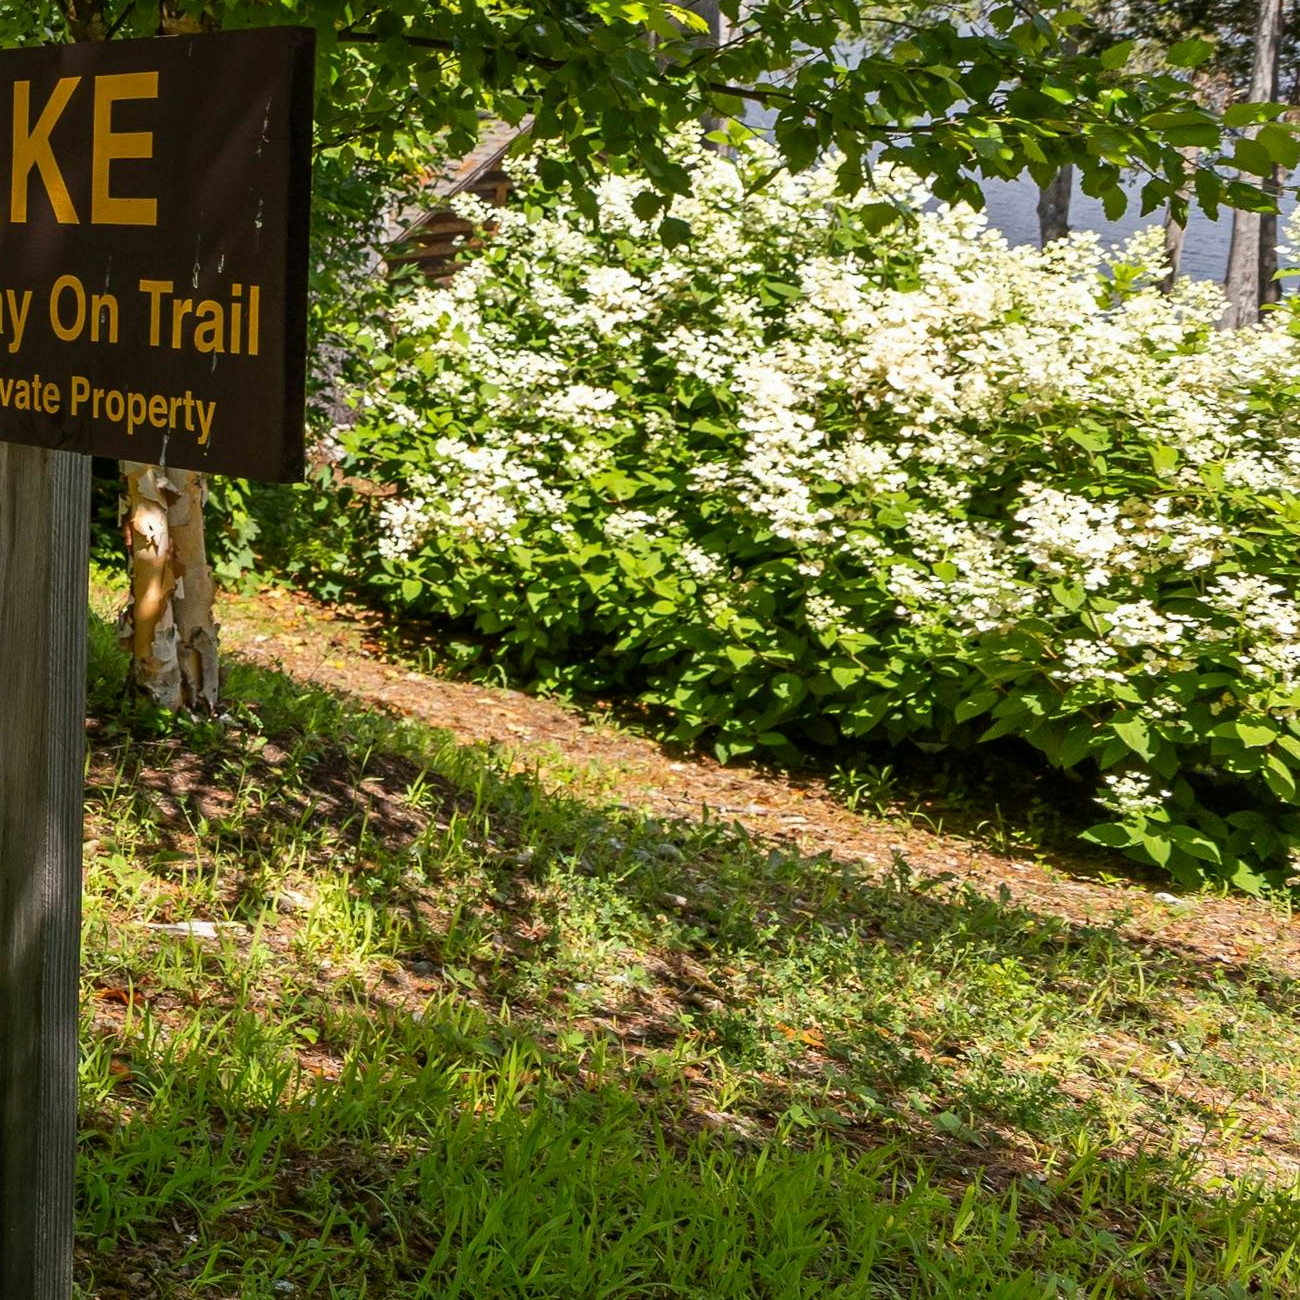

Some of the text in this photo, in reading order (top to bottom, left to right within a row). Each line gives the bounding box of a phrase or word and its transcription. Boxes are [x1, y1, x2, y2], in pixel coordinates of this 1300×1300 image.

[50, 275, 118, 343] On
[139, 279, 259, 355] Trail
[72, 376, 216, 444] Property
